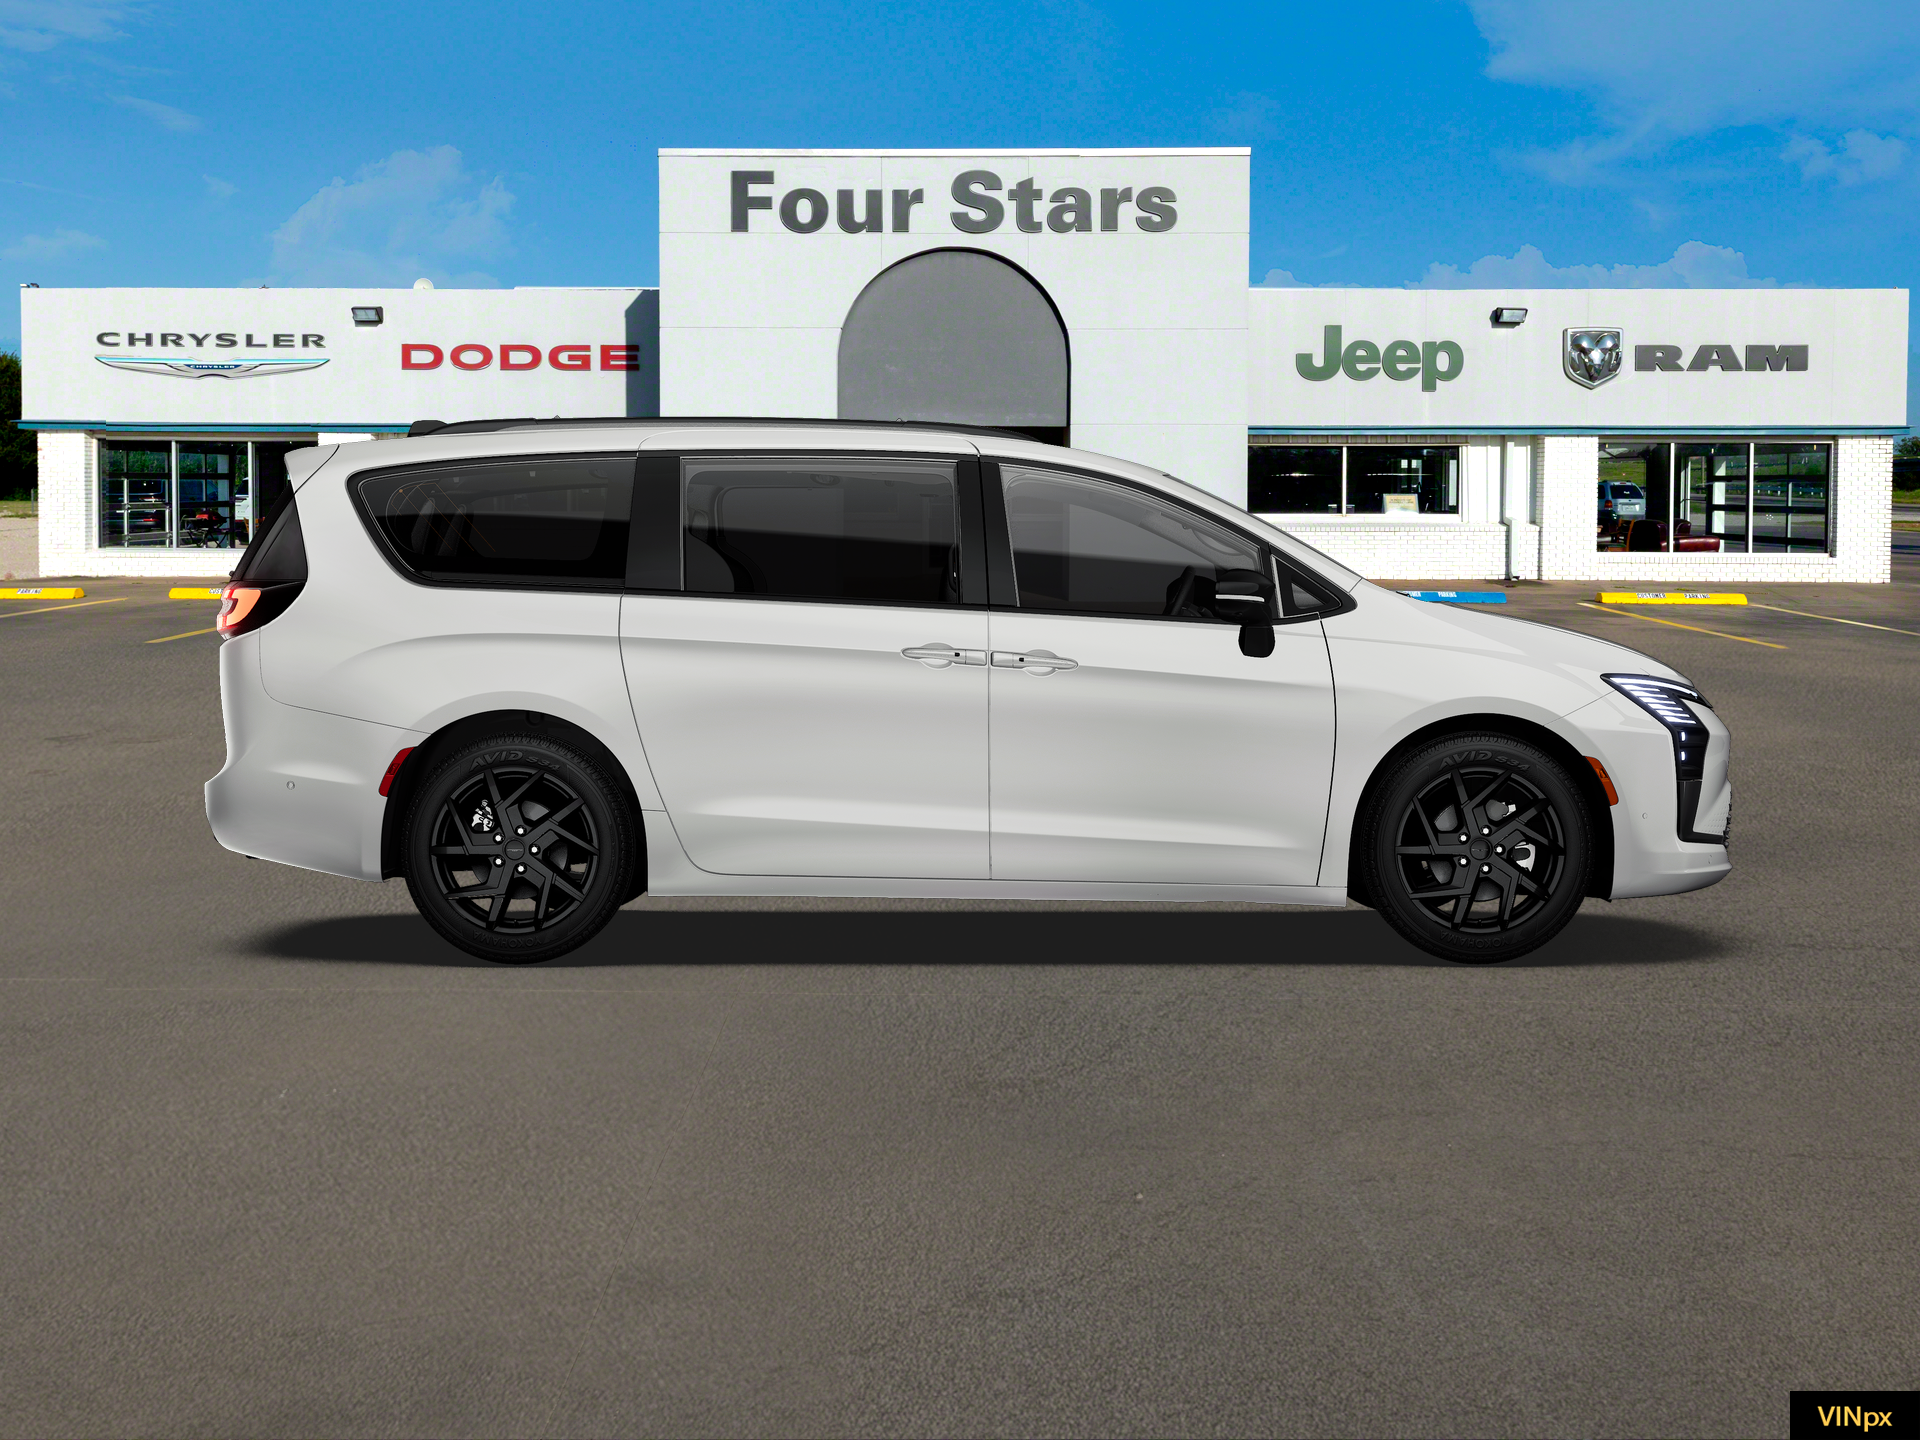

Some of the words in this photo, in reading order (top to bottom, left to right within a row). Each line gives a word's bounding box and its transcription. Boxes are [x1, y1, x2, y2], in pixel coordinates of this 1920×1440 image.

[730, 169, 924, 233] Four
[950, 169, 1178, 234] Stars
[96, 332, 326, 348] CHRYSLER
[401, 343, 640, 371] DODGE
[1296, 325, 1464, 392] Jeep
[1634, 344, 1809, 371] RAM
[469, 750, 523, 772] AVID
[1437, 750, 1492, 772] AVID
[473, 929, 542, 948] YOKOHAMA
[1440, 929, 1509, 948] YOKOHAMA
